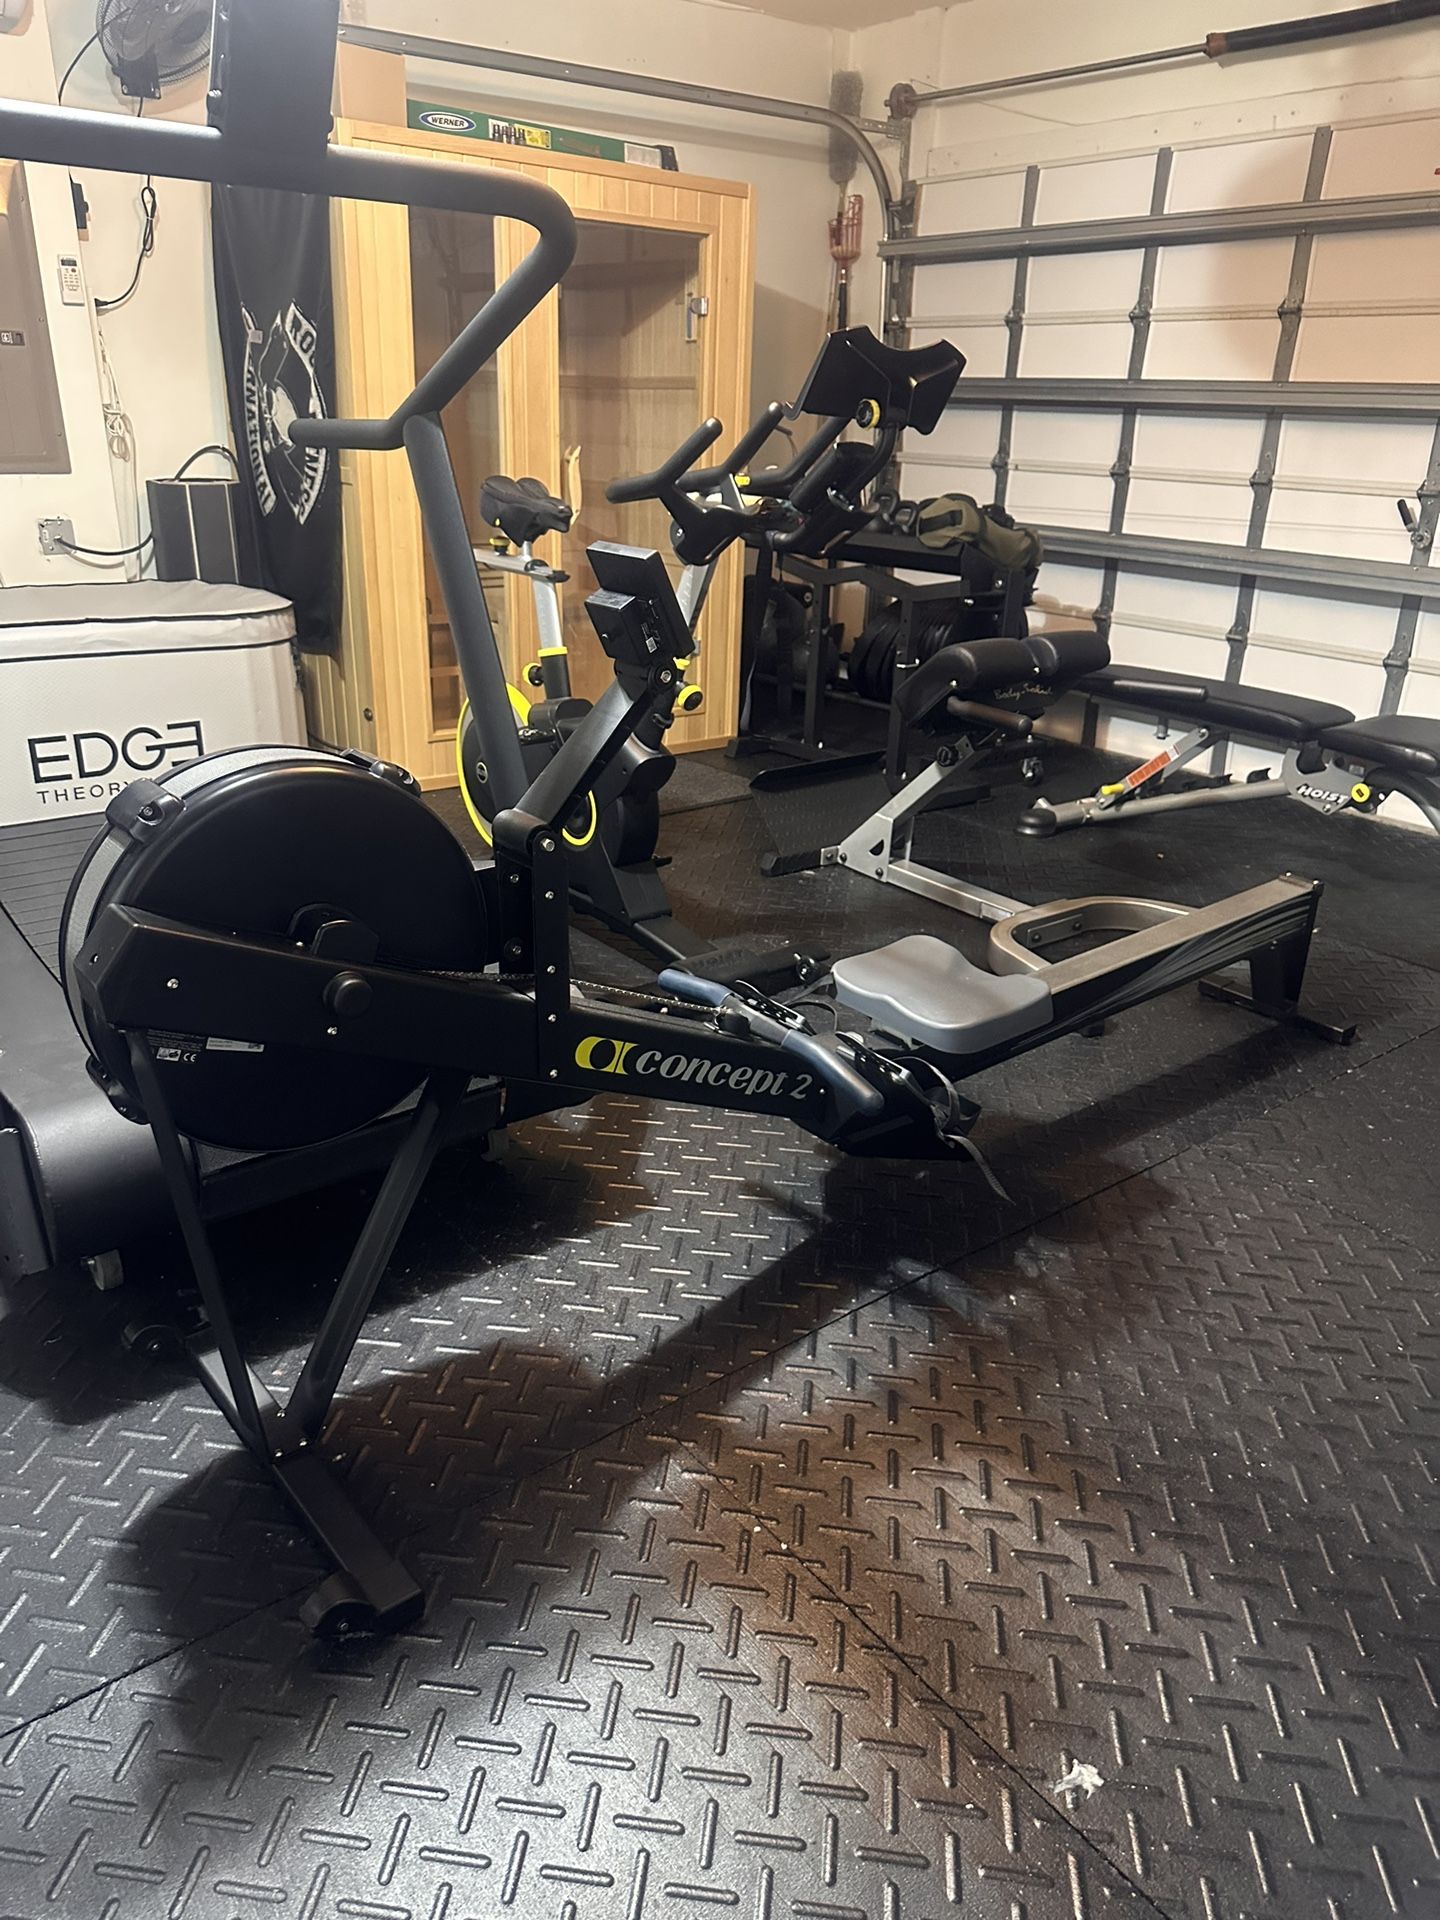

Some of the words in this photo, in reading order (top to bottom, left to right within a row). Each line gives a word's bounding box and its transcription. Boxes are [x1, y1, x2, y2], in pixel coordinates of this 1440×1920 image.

[431, 116, 465, 127] WERNER
[27, 720, 204, 784] EDGE
[36, 780, 129, 804] THEOR
[1297, 784, 1349, 804] HOIST
[635, 1050, 788, 1096] concept
[791, 1073, 813, 1100] 2
